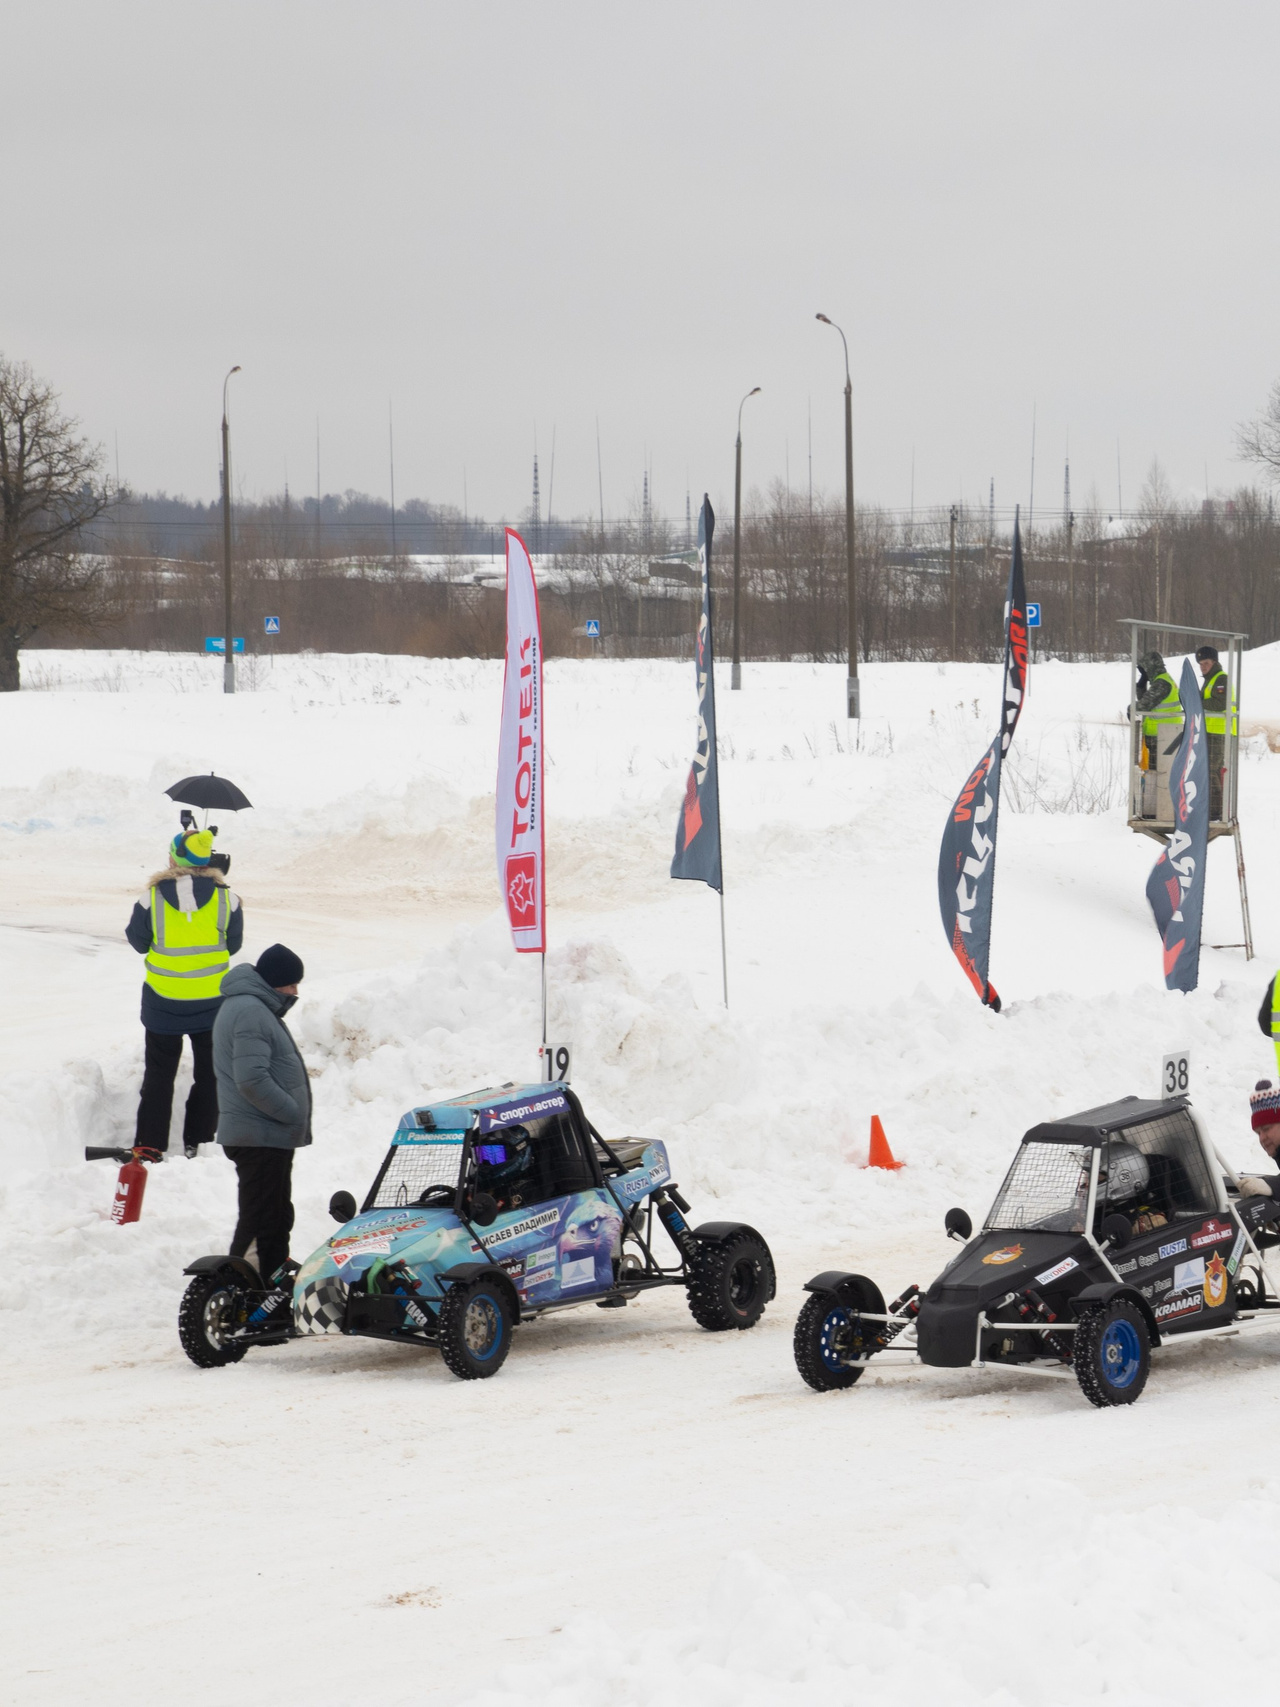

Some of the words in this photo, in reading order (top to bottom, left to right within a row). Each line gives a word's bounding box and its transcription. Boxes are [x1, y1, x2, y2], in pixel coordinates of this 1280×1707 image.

[545, 1046, 570, 1082] 19
[1166, 1058, 1189, 1093] 38
[407, 1131, 465, 1142] Раменское
[649, 1165, 666, 1179] NWB
[626, 1178, 649, 1193] RUSTA
[482, 1230, 513, 1247] ИСАЕВ
[514, 1209, 558, 1235] ВЛАДИМИР
[1160, 1240, 1187, 1258] RUSTA
[1040, 1265, 1067, 1283] DRYDRY
[1155, 1294, 1201, 1318] KRAMAR
